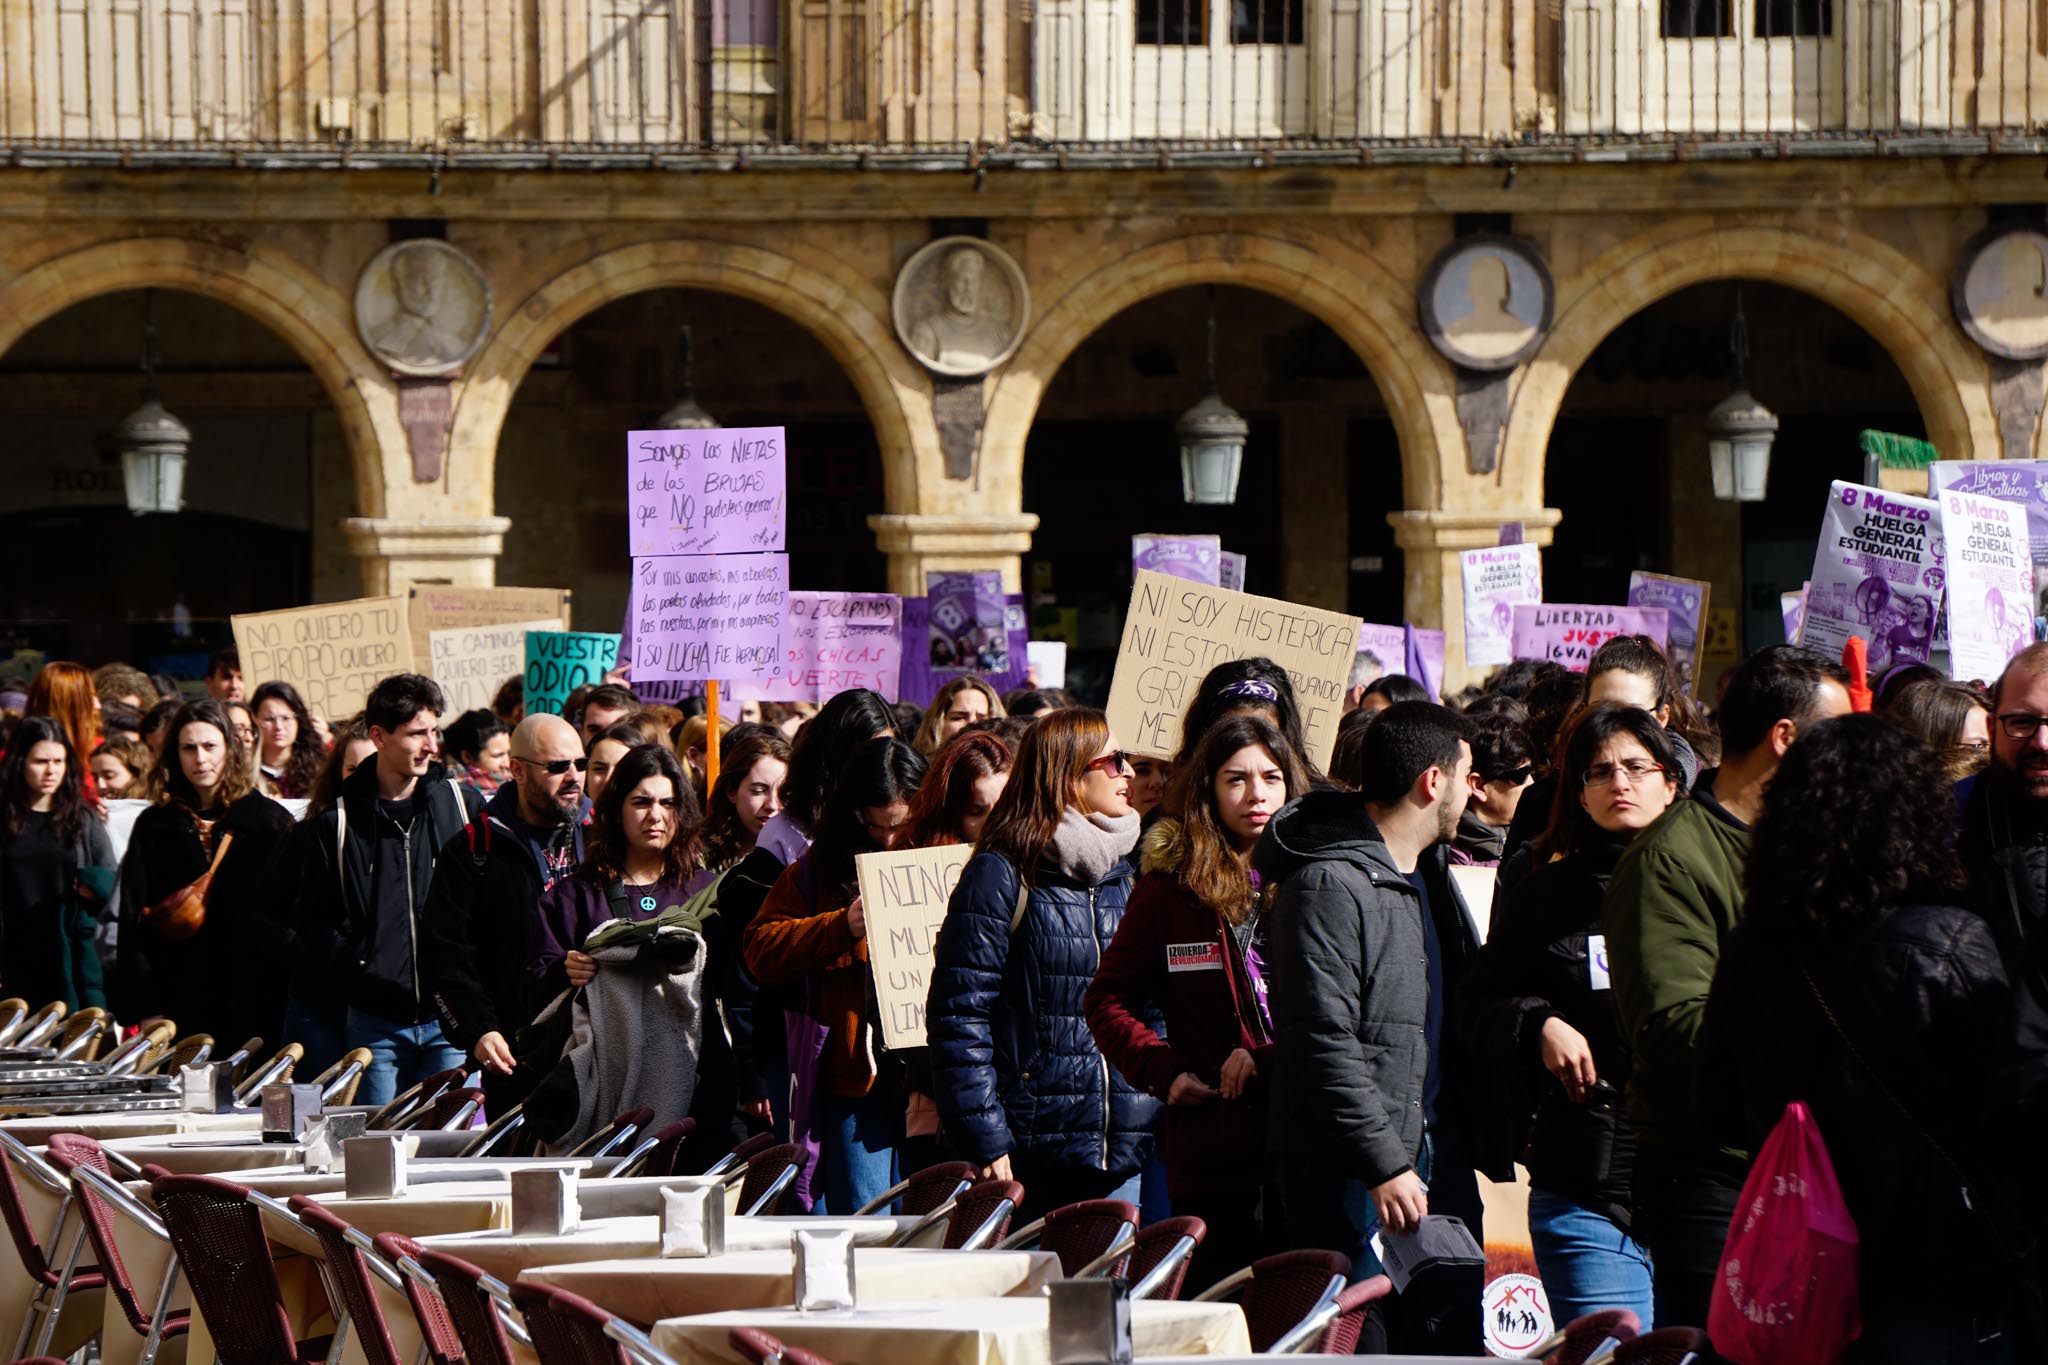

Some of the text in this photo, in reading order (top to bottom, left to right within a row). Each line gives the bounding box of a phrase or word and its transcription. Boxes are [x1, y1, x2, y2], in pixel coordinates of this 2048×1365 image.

[636, 472, 656, 491] de
[704, 470, 765, 493] BRUJAS
[1958, 480, 2030, 498] Cmbativas
[1969, 465, 2022, 491] Libres y
[636, 503, 657, 528] que
[670, 494, 696, 534] NO
[1841, 487, 1930, 522] 8 Marzo
[1949, 496, 2009, 522] 8 Marzo
[1864, 512, 1927, 537] HUELGA
[1972, 521, 2012, 538] HUELGA
[1838, 536, 1922, 565] ESTUDIANTIL
[1852, 526, 1925, 552] GENERAL
[1967, 536, 2014, 555] GENERAL
[1961, 549, 2016, 569] ESTUDIANTIL
[663, 570, 680, 585] mis
[811, 599, 892, 620] ESCAPAMOS
[1138, 582, 1354, 661] NI SOY HISTÉRICA
[246, 623, 281, 648] NO
[294, 611, 364, 644] QUIERO
[368, 608, 399, 636] TU
[433, 639, 452, 660] DE
[1128, 624, 1158, 659] NI
[251, 641, 397, 687] PIROPO QUIERO
[436, 652, 519, 681] QUIERO SER
[666, 640, 711, 673] LUCHA
[714, 644, 732, 665] FUE
[526, 660, 589, 694] ODIO
[1136, 666, 1205, 709] GRI
[1137, 711, 1177, 750] ME
[889, 923, 945, 959] MU
[1169, 944, 1208, 957] IZQUIERDA
[889, 970, 923, 990] UN
